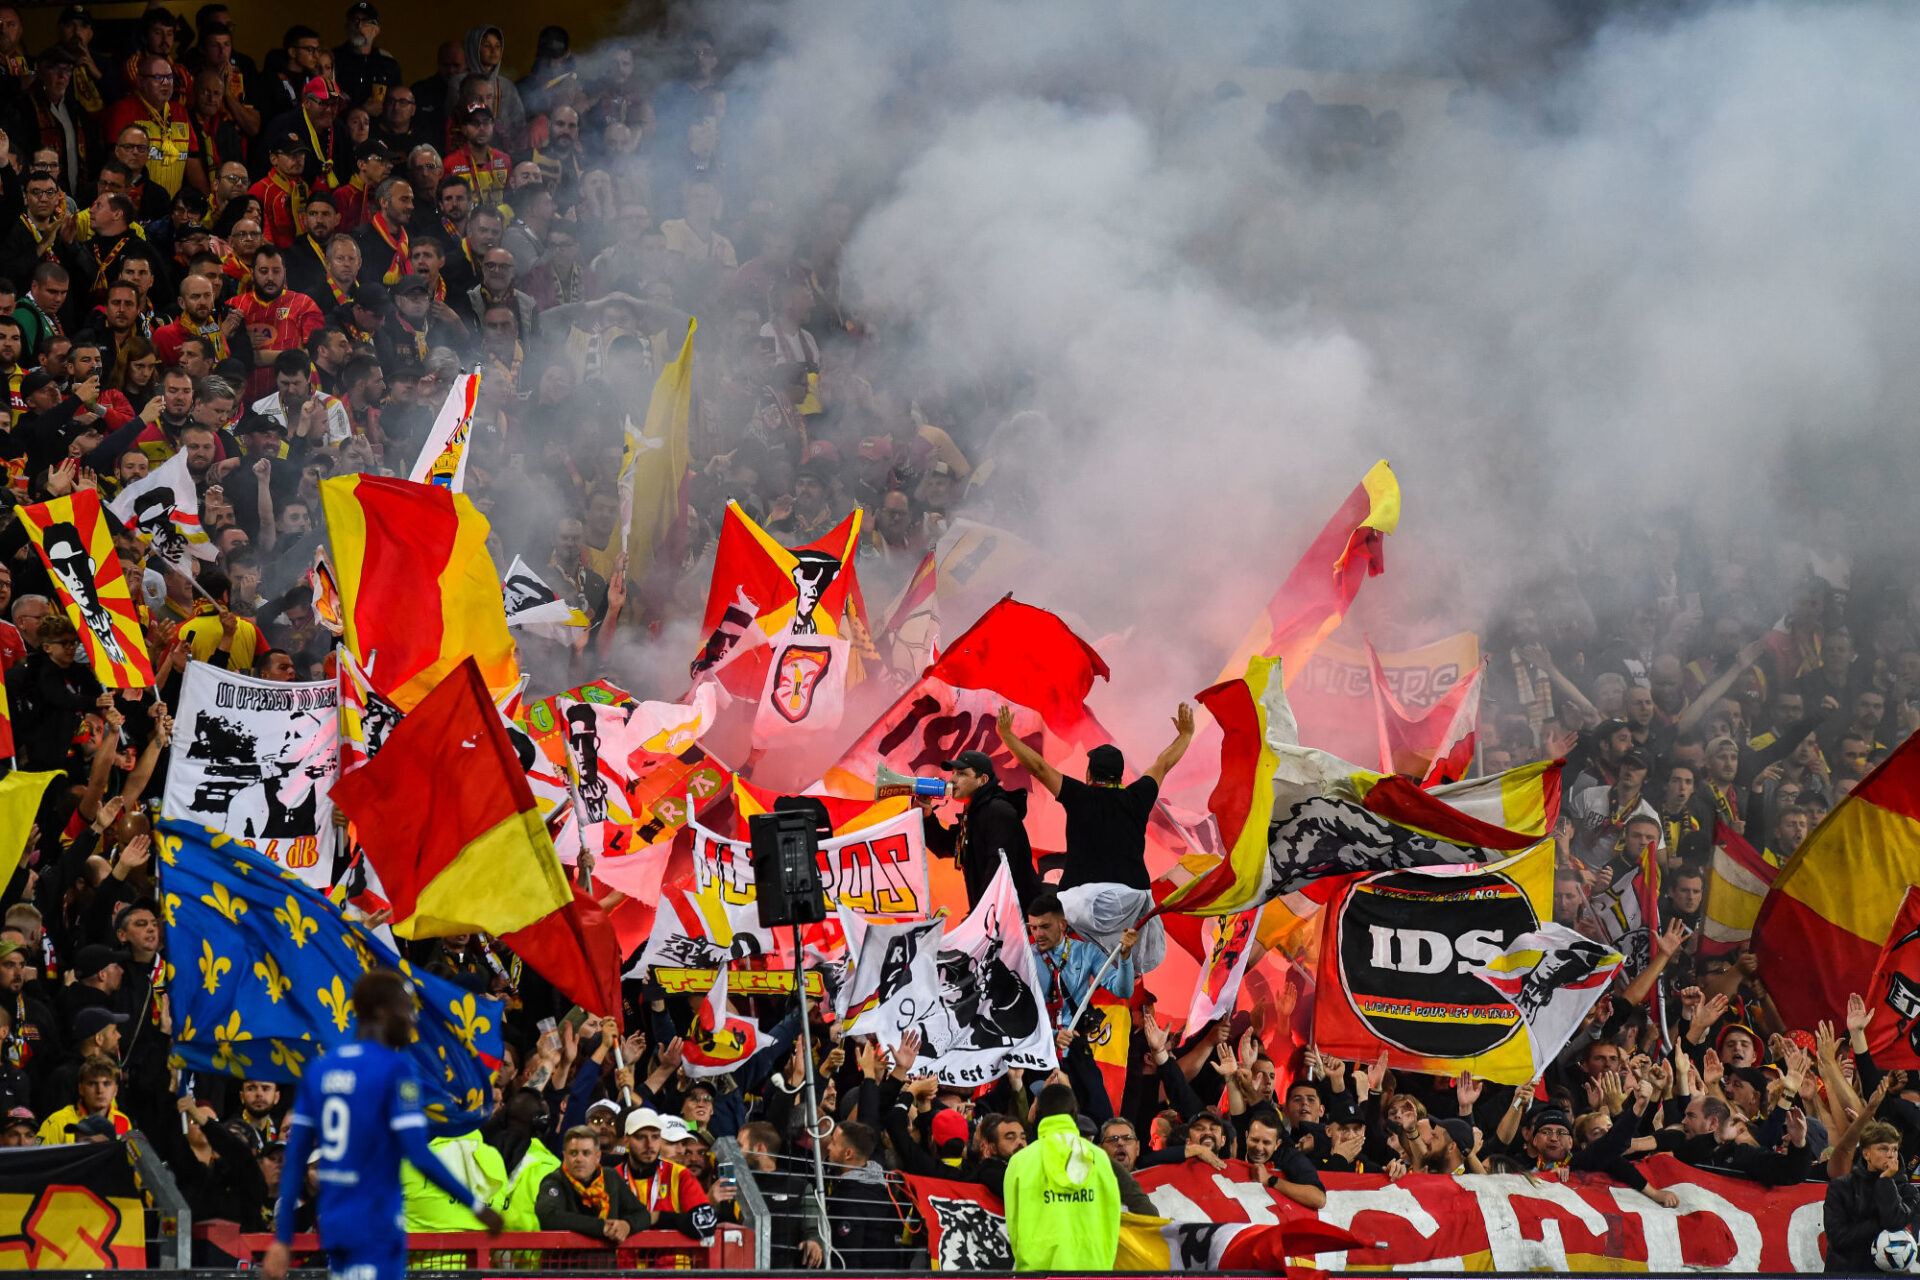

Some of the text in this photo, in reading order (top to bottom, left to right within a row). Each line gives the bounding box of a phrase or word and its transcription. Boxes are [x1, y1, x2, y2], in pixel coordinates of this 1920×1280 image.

[216, 682, 337, 712] UN UPPERCUT DU DRO
[286, 835, 319, 868] dB
[1368, 924, 1504, 976] IDS
[1364, 1001, 1515, 1019] LIBERTÉ POUR LES ULTRAS
[960, 1064, 985, 1082] est
[321, 1096, 350, 1161] 9
[1043, 1188, 1095, 1204] STEWARD
